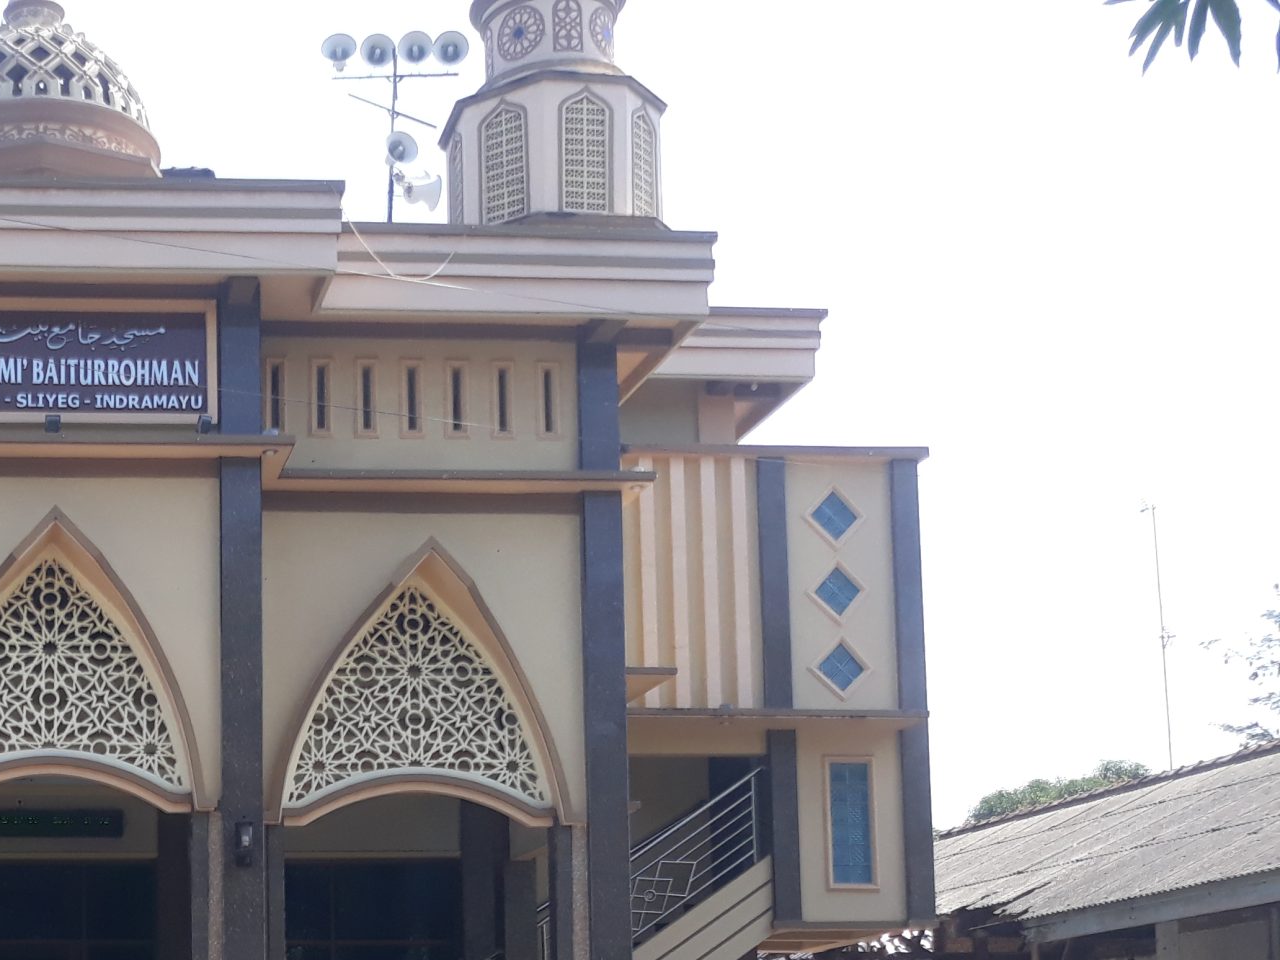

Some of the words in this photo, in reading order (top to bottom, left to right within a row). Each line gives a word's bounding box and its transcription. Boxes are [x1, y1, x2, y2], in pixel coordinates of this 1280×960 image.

[32, 358, 199, 387] BAITURROHMAN
[16, 392, 80, 408] SLIYEG
[94, 394, 203, 410] INDRAMAYU
